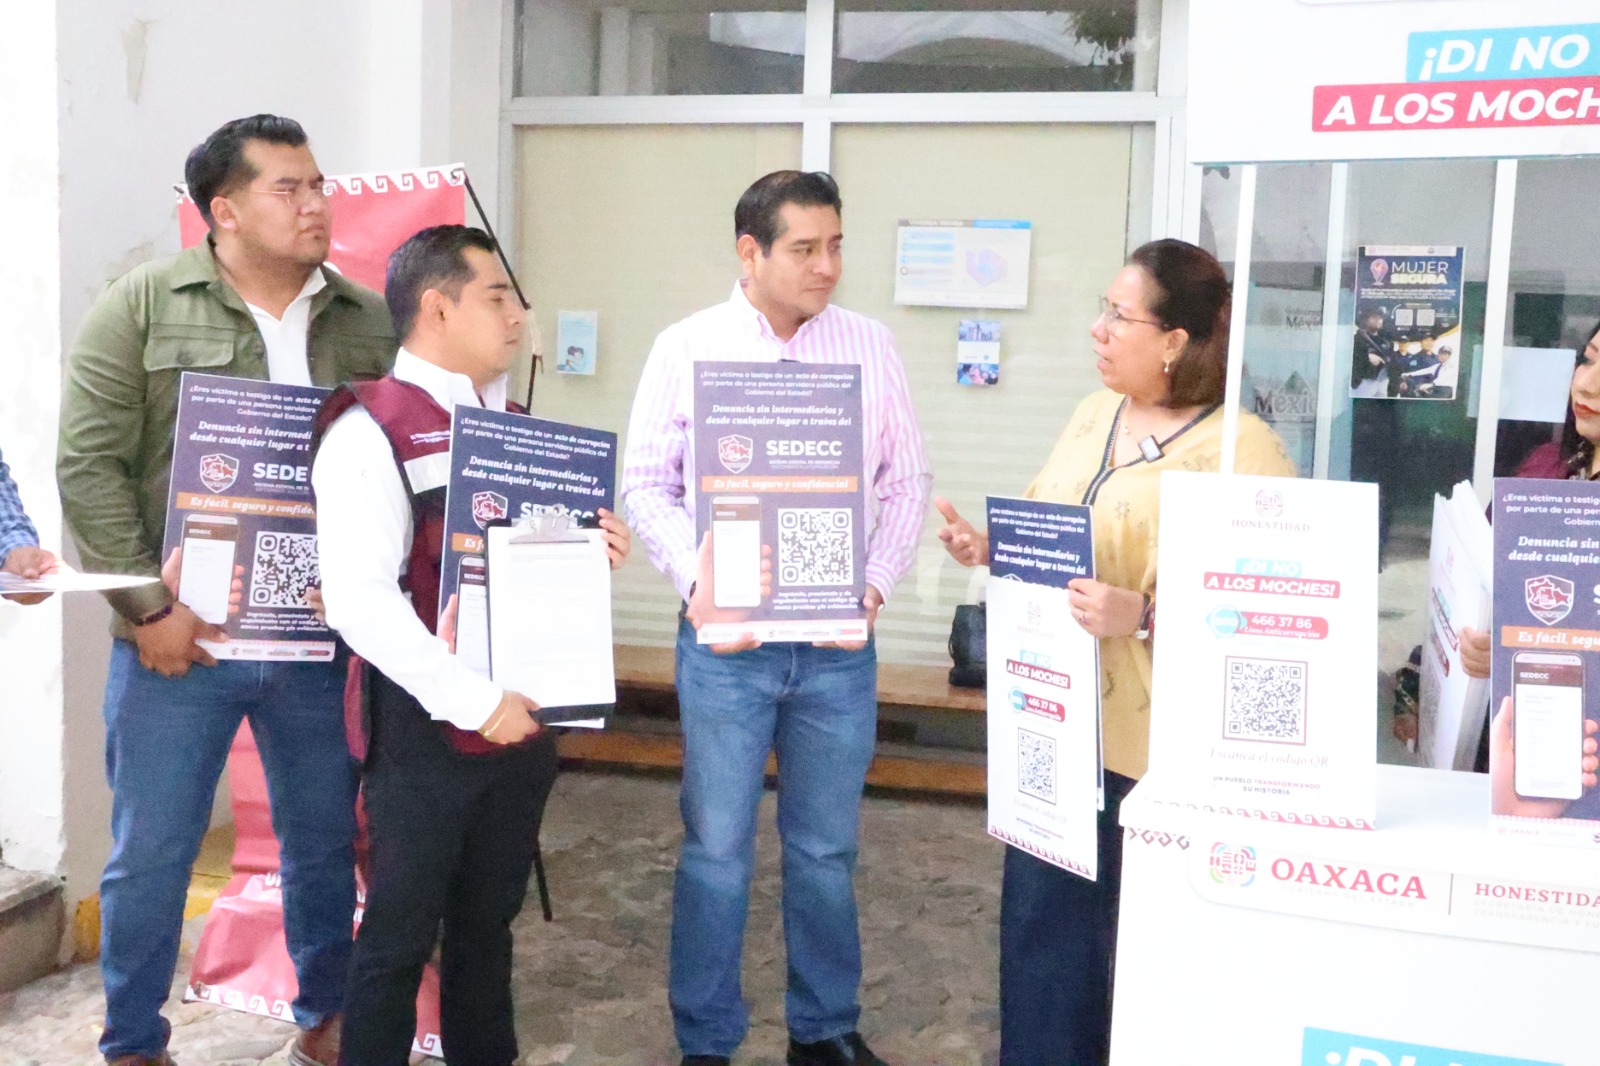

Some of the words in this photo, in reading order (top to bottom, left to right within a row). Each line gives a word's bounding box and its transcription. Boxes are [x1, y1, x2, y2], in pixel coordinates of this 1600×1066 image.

[1419, 39, 1493, 80] ¡DI
[1510, 34, 1589, 71] NO
[1322, 96, 1356, 126] A
[1369, 92, 1457, 124] LOS
[1392, 262, 1448, 273] MUJER
[712, 405, 755, 413] Denuncia
[757, 405, 769, 413] sin
[772, 405, 836, 414] intermediarios
[837, 408, 843, 416] y
[706, 416, 730, 424] desde
[732, 417, 774, 426] cualquier
[777, 417, 801, 427] lugar
[838, 417, 851, 425] del
[198, 421, 246, 433] Denuncia
[248, 426, 262, 435] sin
[265, 427, 312, 438] intermedi
[190, 432, 217, 443] desde
[219, 436, 266, 447] cualquier
[268, 439, 294, 451] lugar
[766, 440, 842, 456] SEDECC
[253, 462, 308, 482] SEDE
[470, 456, 512, 470] Denuncia
[514, 463, 527, 472] sin
[529, 465, 591, 482] intermediarios
[591, 477, 598, 485] y
[462, 468, 486, 479] desde
[489, 474, 532, 485] cualquier
[532, 478, 556, 490] lugar
[592, 487, 605, 496] del
[190, 497, 202, 506] Es
[232, 502, 266, 511] seguro
[268, 504, 273, 513] y
[276, 503, 313, 512] confide
[1503, 494, 1527, 503] ¿Eres
[1524, 505, 1547, 514] parte
[1232, 519, 1310, 532] HONESTIDAD
[464, 538, 476, 548] Es
[1518, 536, 1577, 547] Denuncia
[1580, 537, 1599, 548] sin
[1509, 550, 1542, 561] desde
[1206, 576, 1219, 588] A
[1224, 577, 1256, 590] LOS
[1259, 579, 1336, 596] MOCHES!
[1252, 615, 1276, 626] 466
[1278, 617, 1293, 626] 37
[1296, 619, 1312, 629] 86
[1518, 631, 1533, 643] Es
[1008, 663, 1013, 672] A
[1015, 663, 1029, 677] LOS
[1520, 671, 1549, 680] SEDECC
[1254, 787, 1290, 795] HISTORIA
[1271, 858, 1427, 900] OAXACA
